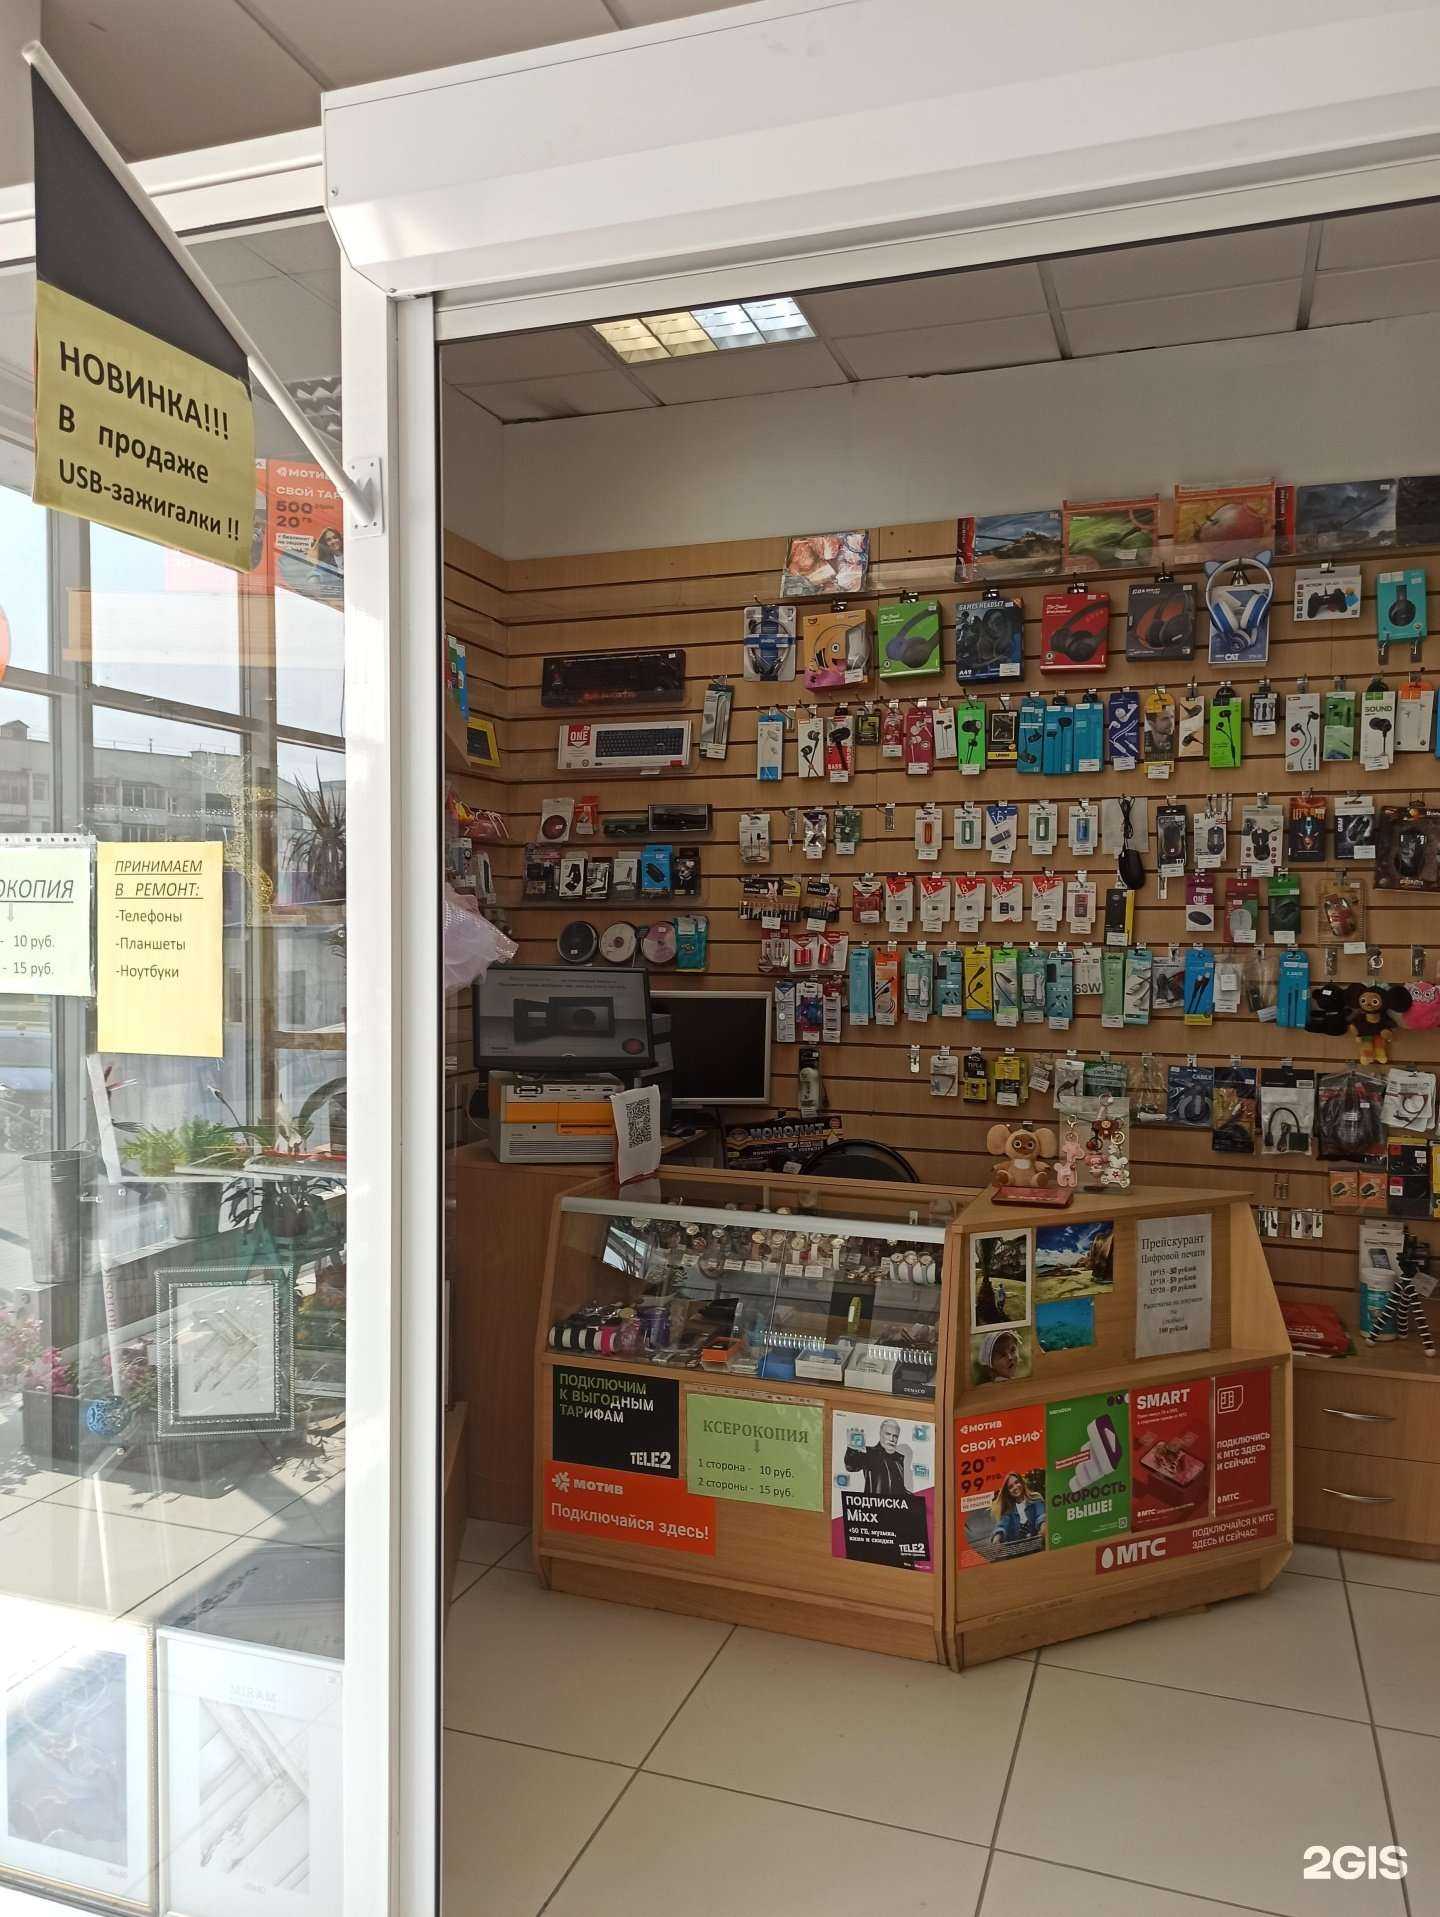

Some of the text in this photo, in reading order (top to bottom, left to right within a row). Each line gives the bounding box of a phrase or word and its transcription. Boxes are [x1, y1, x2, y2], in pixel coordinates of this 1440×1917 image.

[59, 340, 229, 440] НОВИНКА!!!
[58, 403, 210, 484] В продаже
[288, 468, 328, 480] МОТИ
[58, 458, 222, 536] USB-зажигалки
[276, 486, 343, 500] СВОЙ ТАР
[276, 500, 313, 514] 500
[276, 515, 300, 528] 20
[1364, 705, 1393, 713] SOUND
[115, 859, 203, 873] ПРИНИМАЕМ
[115, 882, 200, 897] В РЕМОНТ:
[14, 935, 27, 947] 10
[31, 934, 55, 950] руб.
[14, 962, 27, 974] 15
[31, 962, 54, 977] руб.
[1141, 1234, 1205, 1251] Прейскурант
[559, 1373, 647, 1395] ПОДКЛЮЧИМ
[559, 1388, 654, 1412] К ВЫГОДНЫМ
[1136, 1388, 1190, 1410] SMART
[559, 1403, 624, 1423] ТАРИФАМ
[702, 1419, 809, 1444] КСЕРОКОПИЯ
[969, 1420, 1003, 1433] МОТИВ
[960, 1430, 1041, 1454] СВОЙ ТАРИФ
[1216, 1432, 1271, 1449] ПОДКЛЮЧИСЬ
[630, 1451, 672, 1470] TELE2
[1216, 1444, 1266, 1460] К МТС ЗДЕСЬ
[705, 1460, 746, 1474] сторона
[759, 1465, 771, 1476] 10
[773, 1466, 795, 1480] руб.
[961, 1459, 985, 1475] 20
[1216, 1456, 1257, 1471] И СЕЙЧАС!
[705, 1479, 748, 1492] стороны
[759, 1484, 771, 1495] 15
[773, 1486, 795, 1499] руб.
[961, 1477, 985, 1493] 99
[845, 1495, 909, 1510] ПОДПИСКА
[1051, 1480, 1127, 1508] СКОРОСТЬ
[1221, 1492, 1240, 1503] МТС
[847, 1508, 879, 1524] Mixx
[1066, 1500, 1113, 1521] ВЫШЕ!
[551, 1502, 709, 1540] Подключайся здесь!
[1192, 1513, 1275, 1537] ПОДКЛЮЧАЙСЯ К МТС
[1192, 1537, 1218, 1550] ЗДЕСЬ
[1225, 1528, 1258, 1544] СЕЙЧАС!
[899, 1543, 926, 1554] TELE2
[1116, 1537, 1167, 1565] МТС
